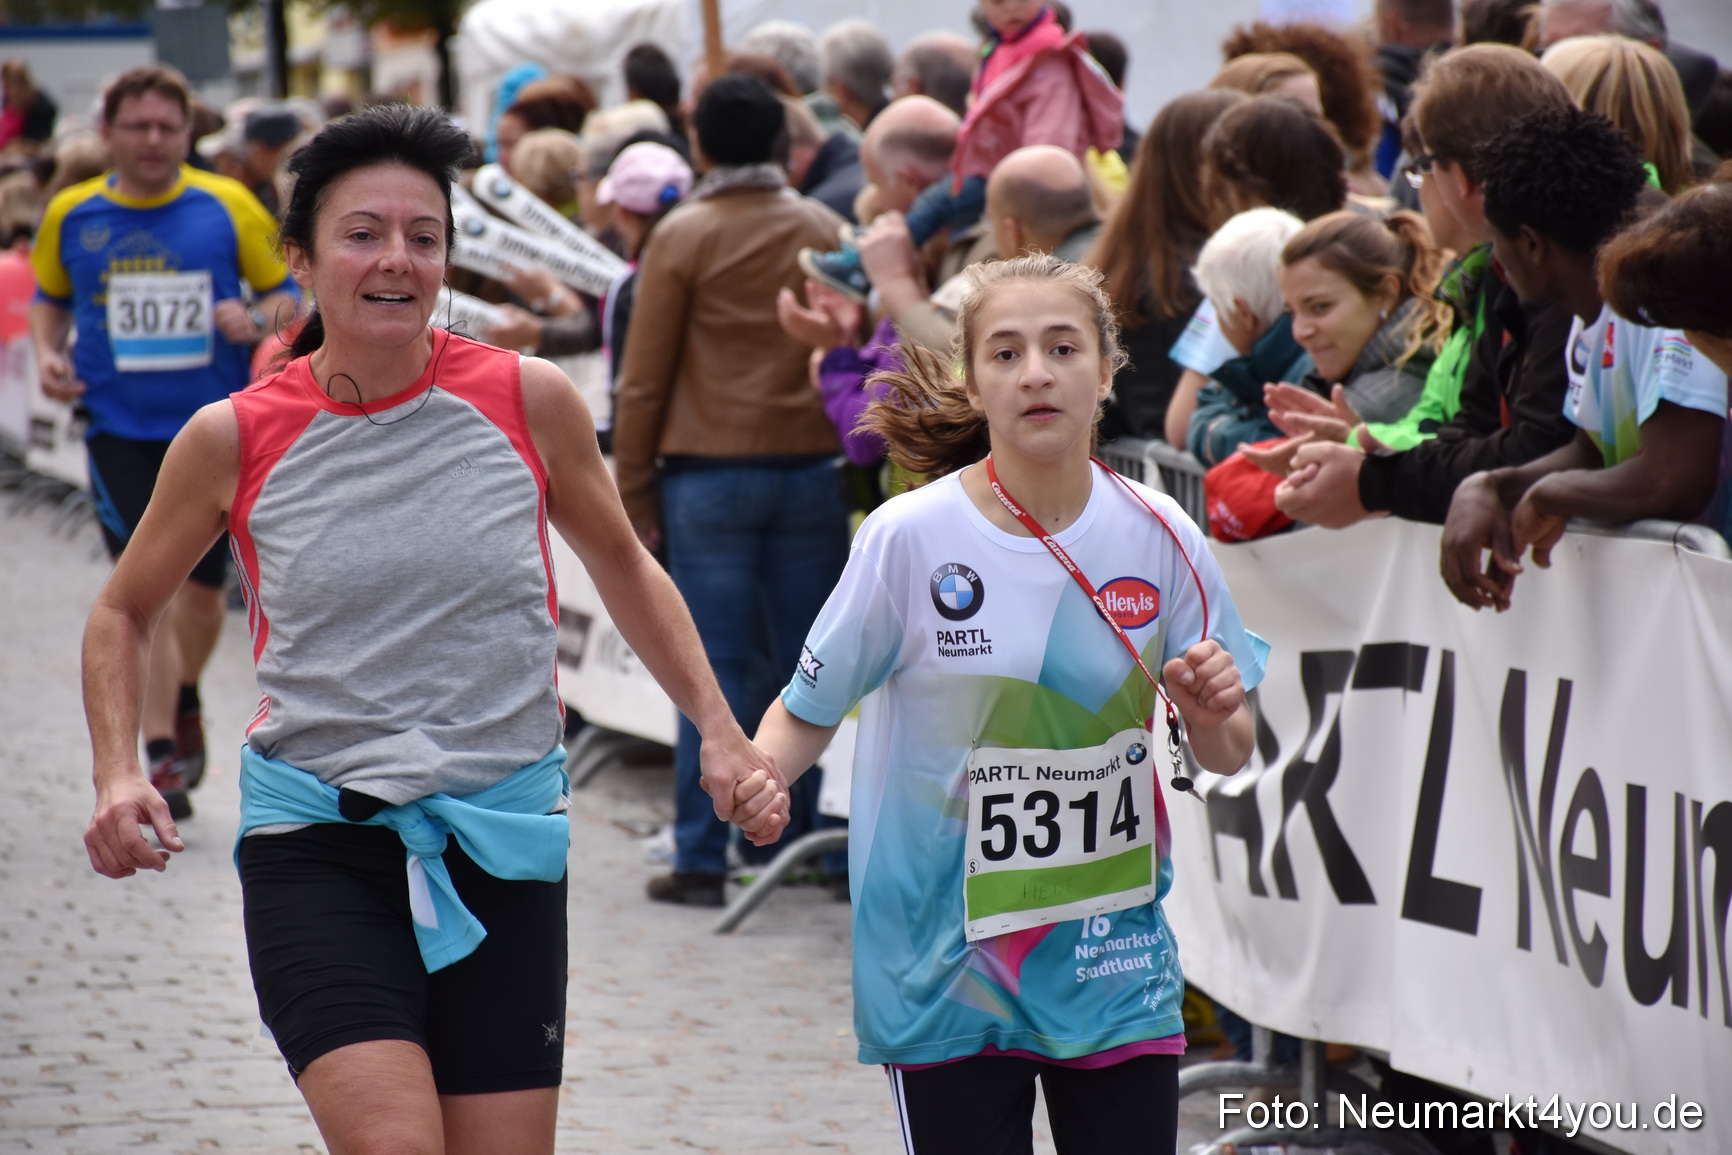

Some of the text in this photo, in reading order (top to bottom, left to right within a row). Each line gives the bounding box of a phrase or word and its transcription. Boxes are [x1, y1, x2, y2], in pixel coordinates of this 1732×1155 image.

[119, 300, 203, 333] 3072
[932, 564, 979, 584] BMW
[1105, 591, 1155, 616] Hervis
[936, 628, 992, 646] PARTL
[938, 644, 993, 658] Neumarkt
[969, 755, 1122, 787] PARTL Neumarkt
[1185, 642, 1483, 937] ARTL
[980, 775, 1141, 862] 5314
[1076, 953, 1153, 983] Stadtlauf
